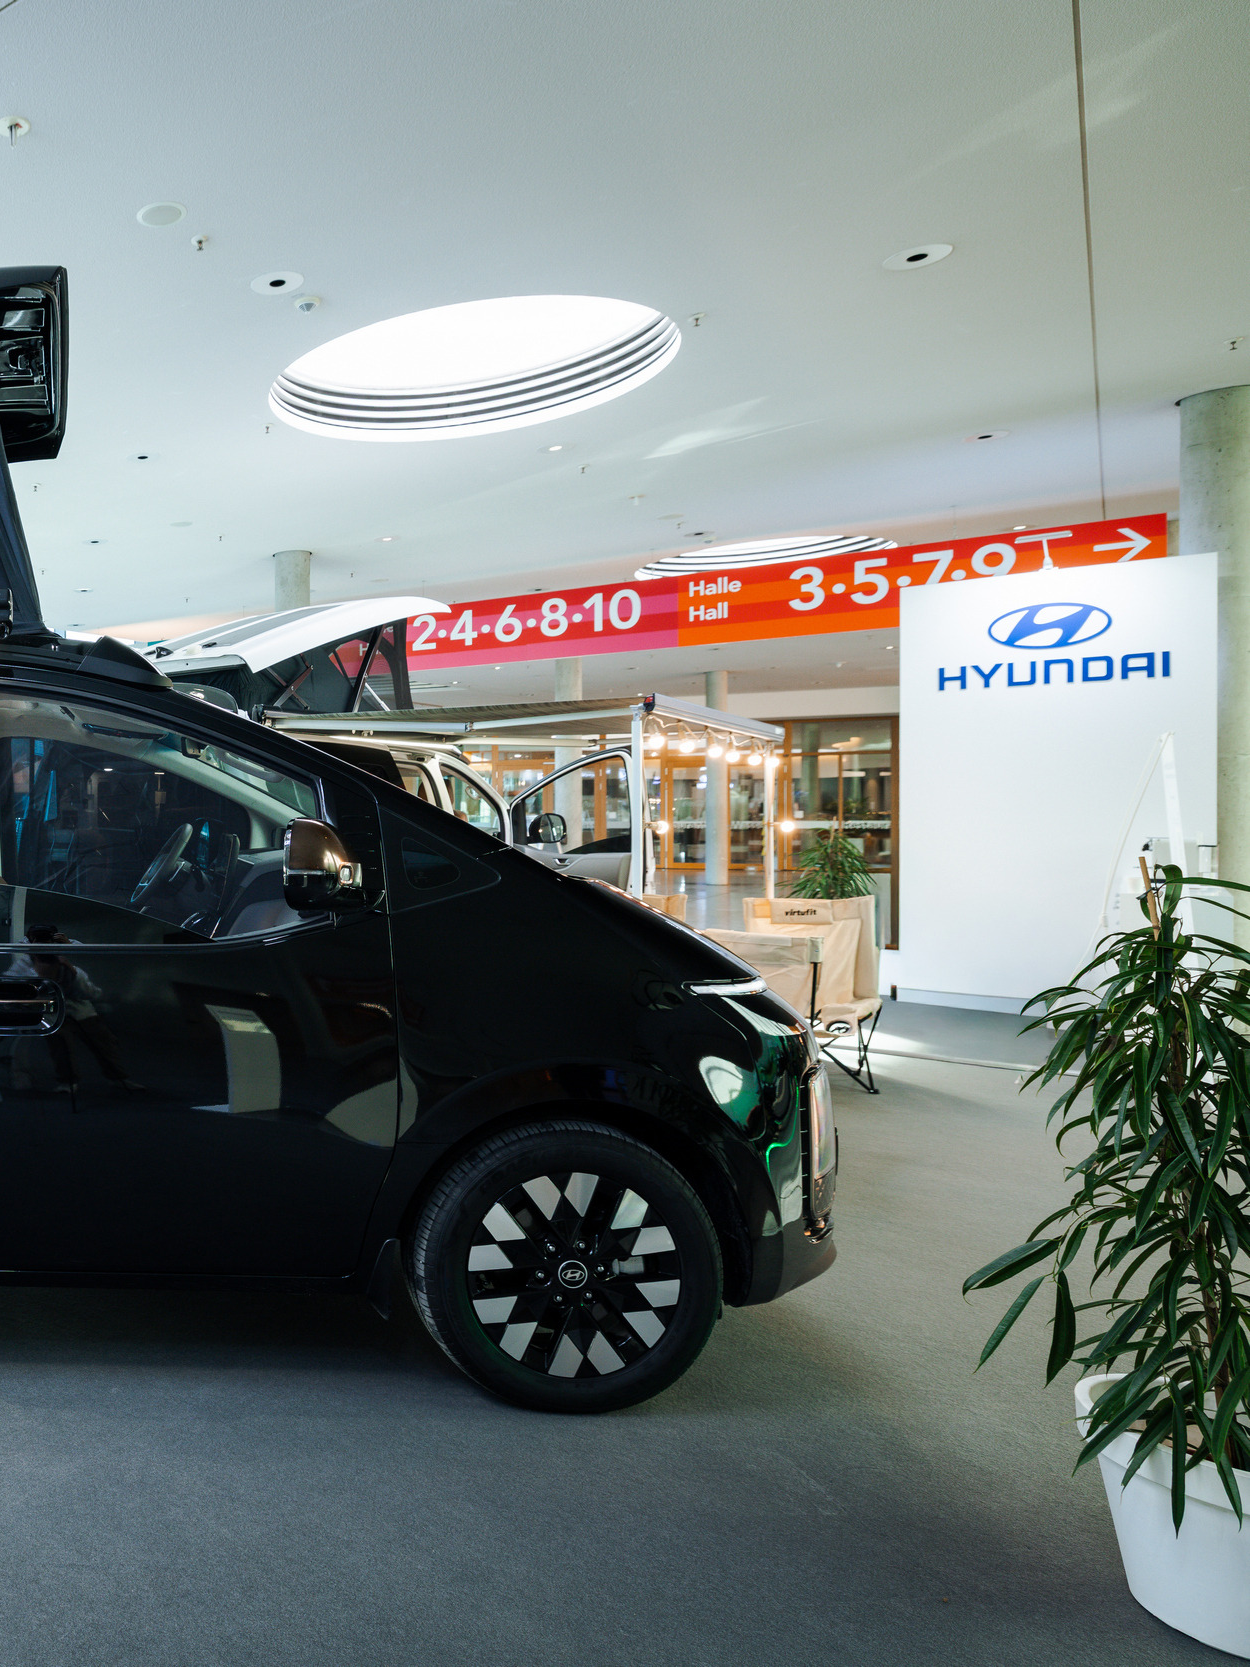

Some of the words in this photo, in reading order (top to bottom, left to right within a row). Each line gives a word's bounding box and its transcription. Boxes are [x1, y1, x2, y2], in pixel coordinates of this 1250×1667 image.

[688, 576, 742, 597] Halle
[688, 602, 729, 622] Hall
[938, 651, 1171, 691] HYUNDAI
[784, 908, 817, 916] virtufit
